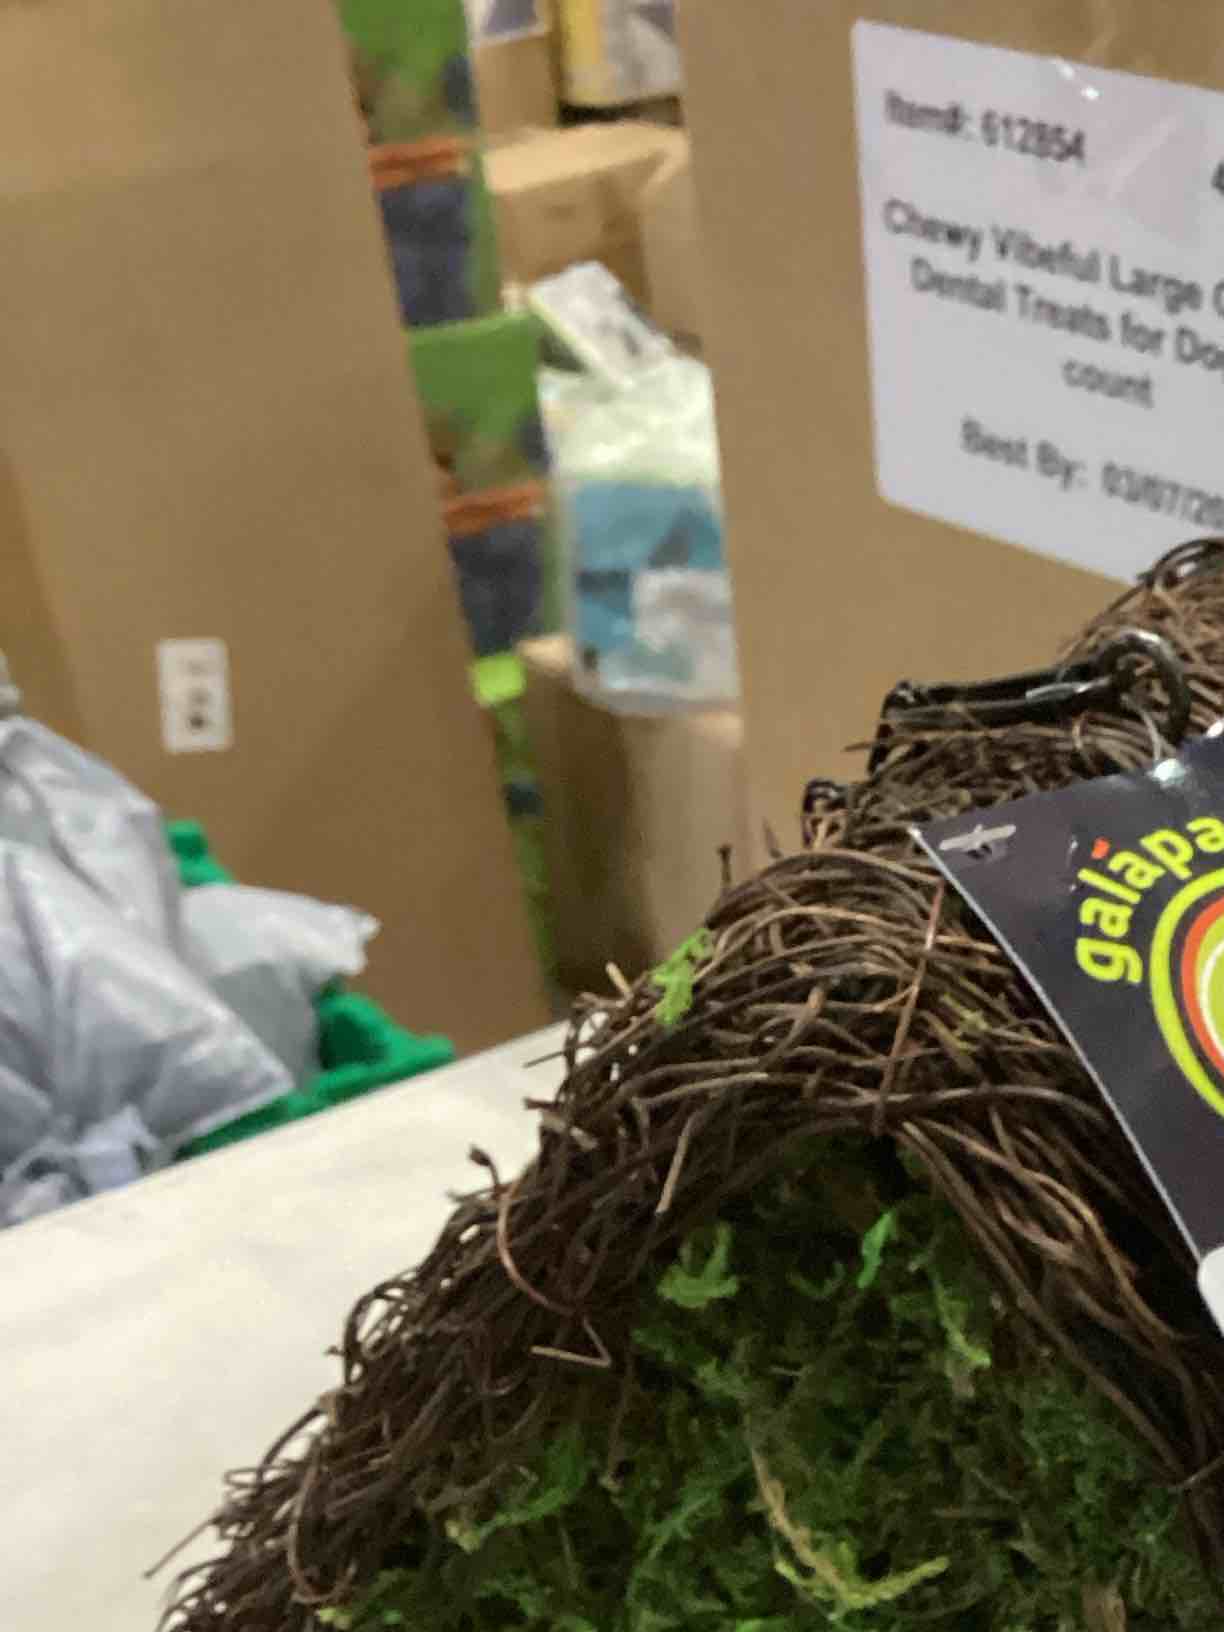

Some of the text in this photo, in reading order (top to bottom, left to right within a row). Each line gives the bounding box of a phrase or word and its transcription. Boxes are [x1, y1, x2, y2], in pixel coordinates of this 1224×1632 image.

[883, 199, 982, 262] Chewy
[990, 225, 1098, 284] Vibeful
[1109, 253, 1203, 315] Large
[910, 257, 1006, 313] Dental
[1014, 282, 1111, 341] Treats
[1121, 310, 1164, 356] for
[1061, 359, 1153, 409] count
[961, 415, 1028, 468] Best
[1036, 439, 1087, 491] By:
